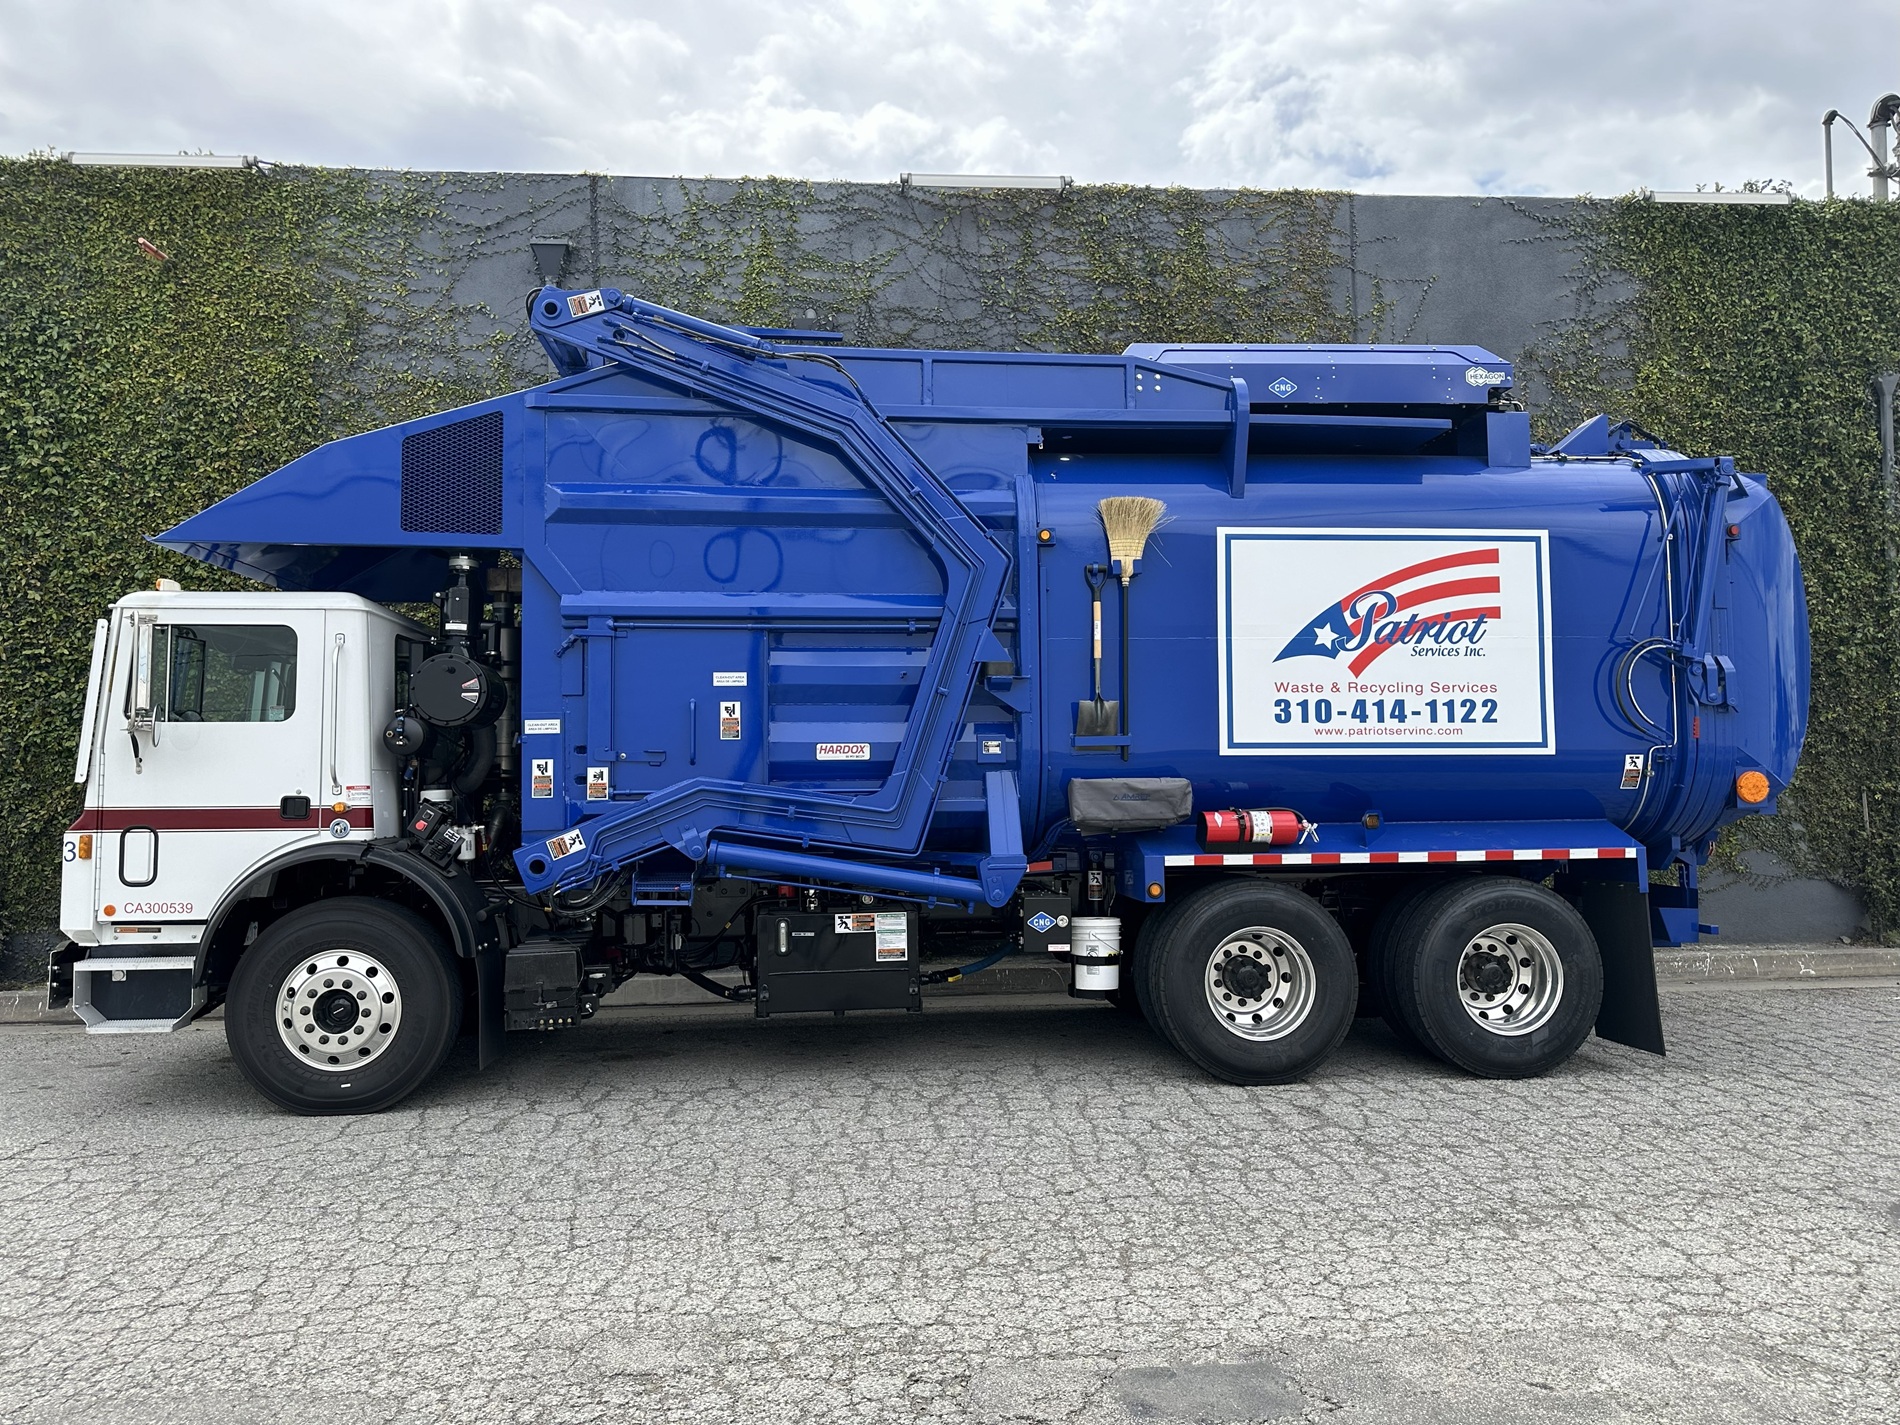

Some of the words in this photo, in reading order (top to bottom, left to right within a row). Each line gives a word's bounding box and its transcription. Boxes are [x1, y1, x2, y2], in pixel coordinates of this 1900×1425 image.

[1274, 383, 1292, 392] CNG
[1335, 590, 1488, 652] Patriot
[1410, 645, 1460, 657] Services
[1463, 645, 1486, 657] Inc.
[1274, 682, 1325, 693] Waste
[1330, 682, 1341, 693] &
[1347, 681, 1424, 696] Recycling
[1430, 682, 1498, 693] Services
[1274, 698, 1498, 724] 310-414-1122
[1314, 727, 1463, 737] www.patriotservinc.com
[819, 744, 866, 755] HARDOX
[63, 841, 77, 862] 3
[124, 902, 194, 914] CA300539
[1033, 918, 1051, 926] CNG
